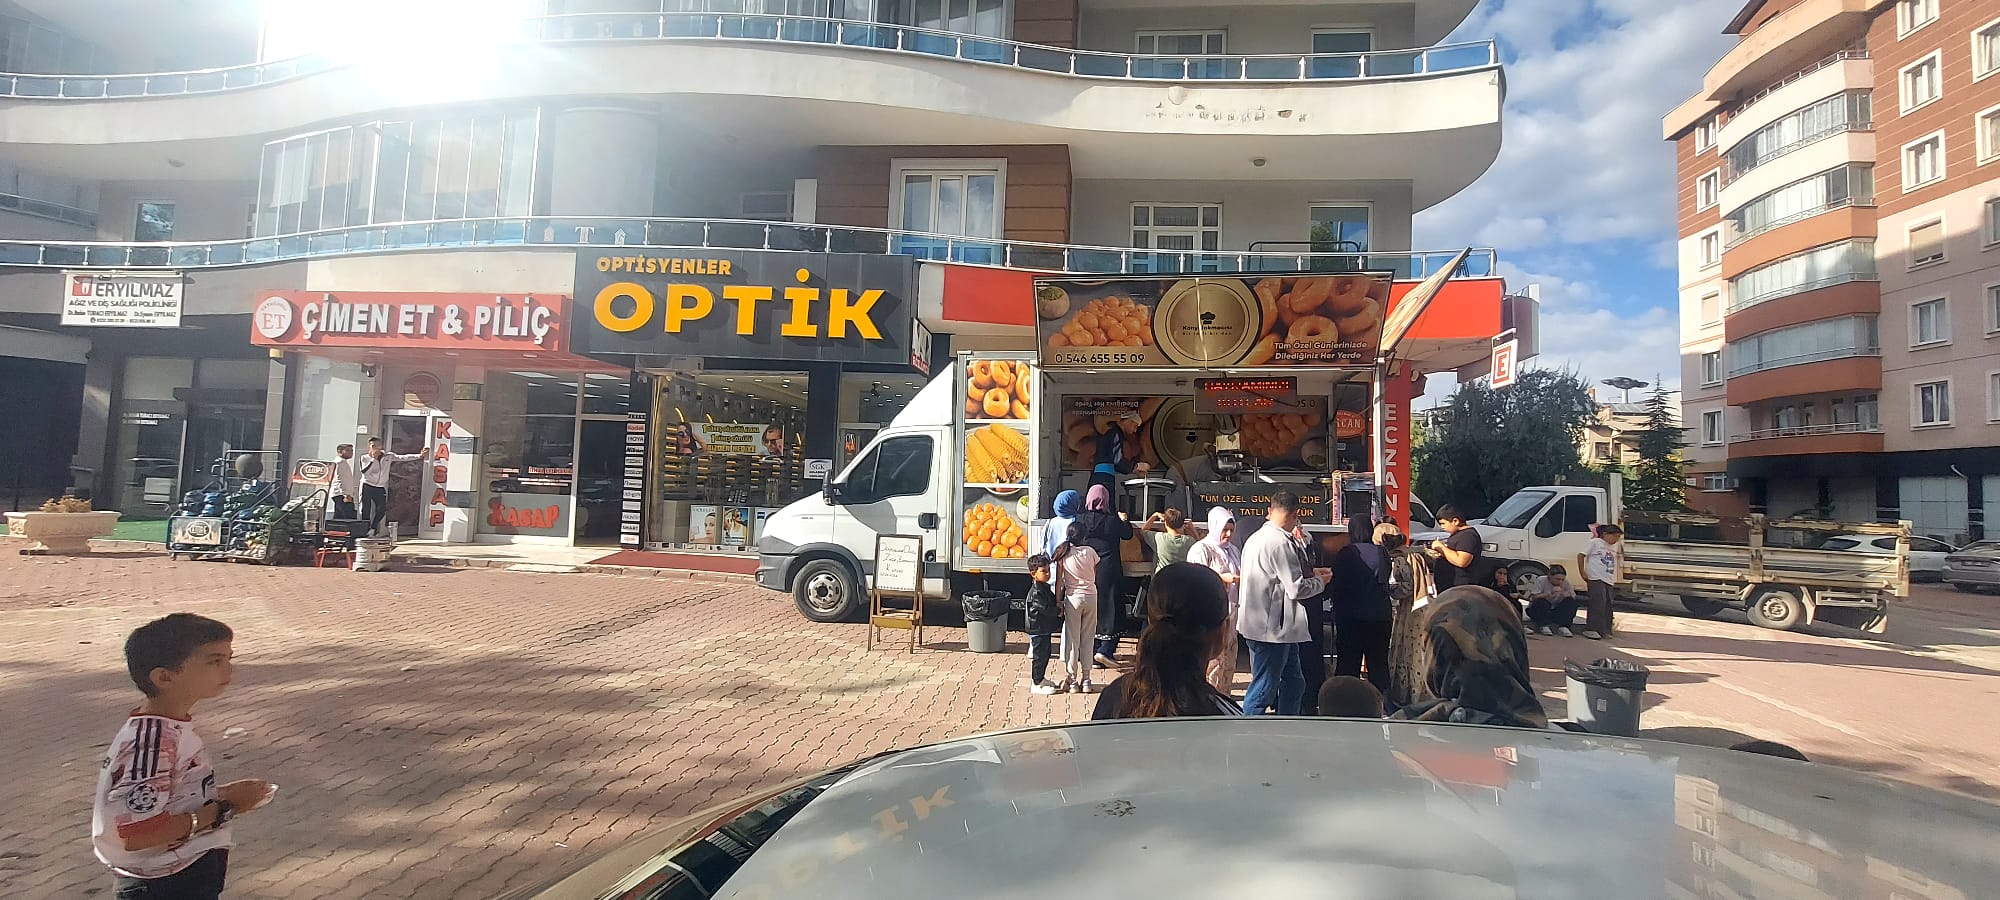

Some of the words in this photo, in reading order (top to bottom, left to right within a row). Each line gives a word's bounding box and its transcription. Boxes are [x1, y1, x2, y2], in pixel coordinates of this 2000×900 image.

[596, 253, 732, 276] OPTİSYENLER
[95, 282, 174, 297] ERYILMAZ
[593, 268, 886, 340] OPTİK
[262, 312, 285, 330] ET
[301, 293, 389, 340] ÇİMEN
[399, 304, 435, 334] ET
[441, 304, 463, 335] &
[474, 296, 550, 344] PİLİÇ
[1293, 340, 1312, 349] Özel
[1313, 341, 1368, 349] Günlerinizde
[1338, 351, 1362, 359] Yerde
[1055, 353, 1063, 364] 0
[1066, 353, 1087, 364] 546
[1090, 353, 1110, 364] 655
[1113, 353, 1127, 364] 55
[1130, 353, 1145, 364] 09
[1497, 354, 1507, 376] E
[1384, 404, 1398, 511] ECZAN
[430, 421, 451, 527] KASAP
